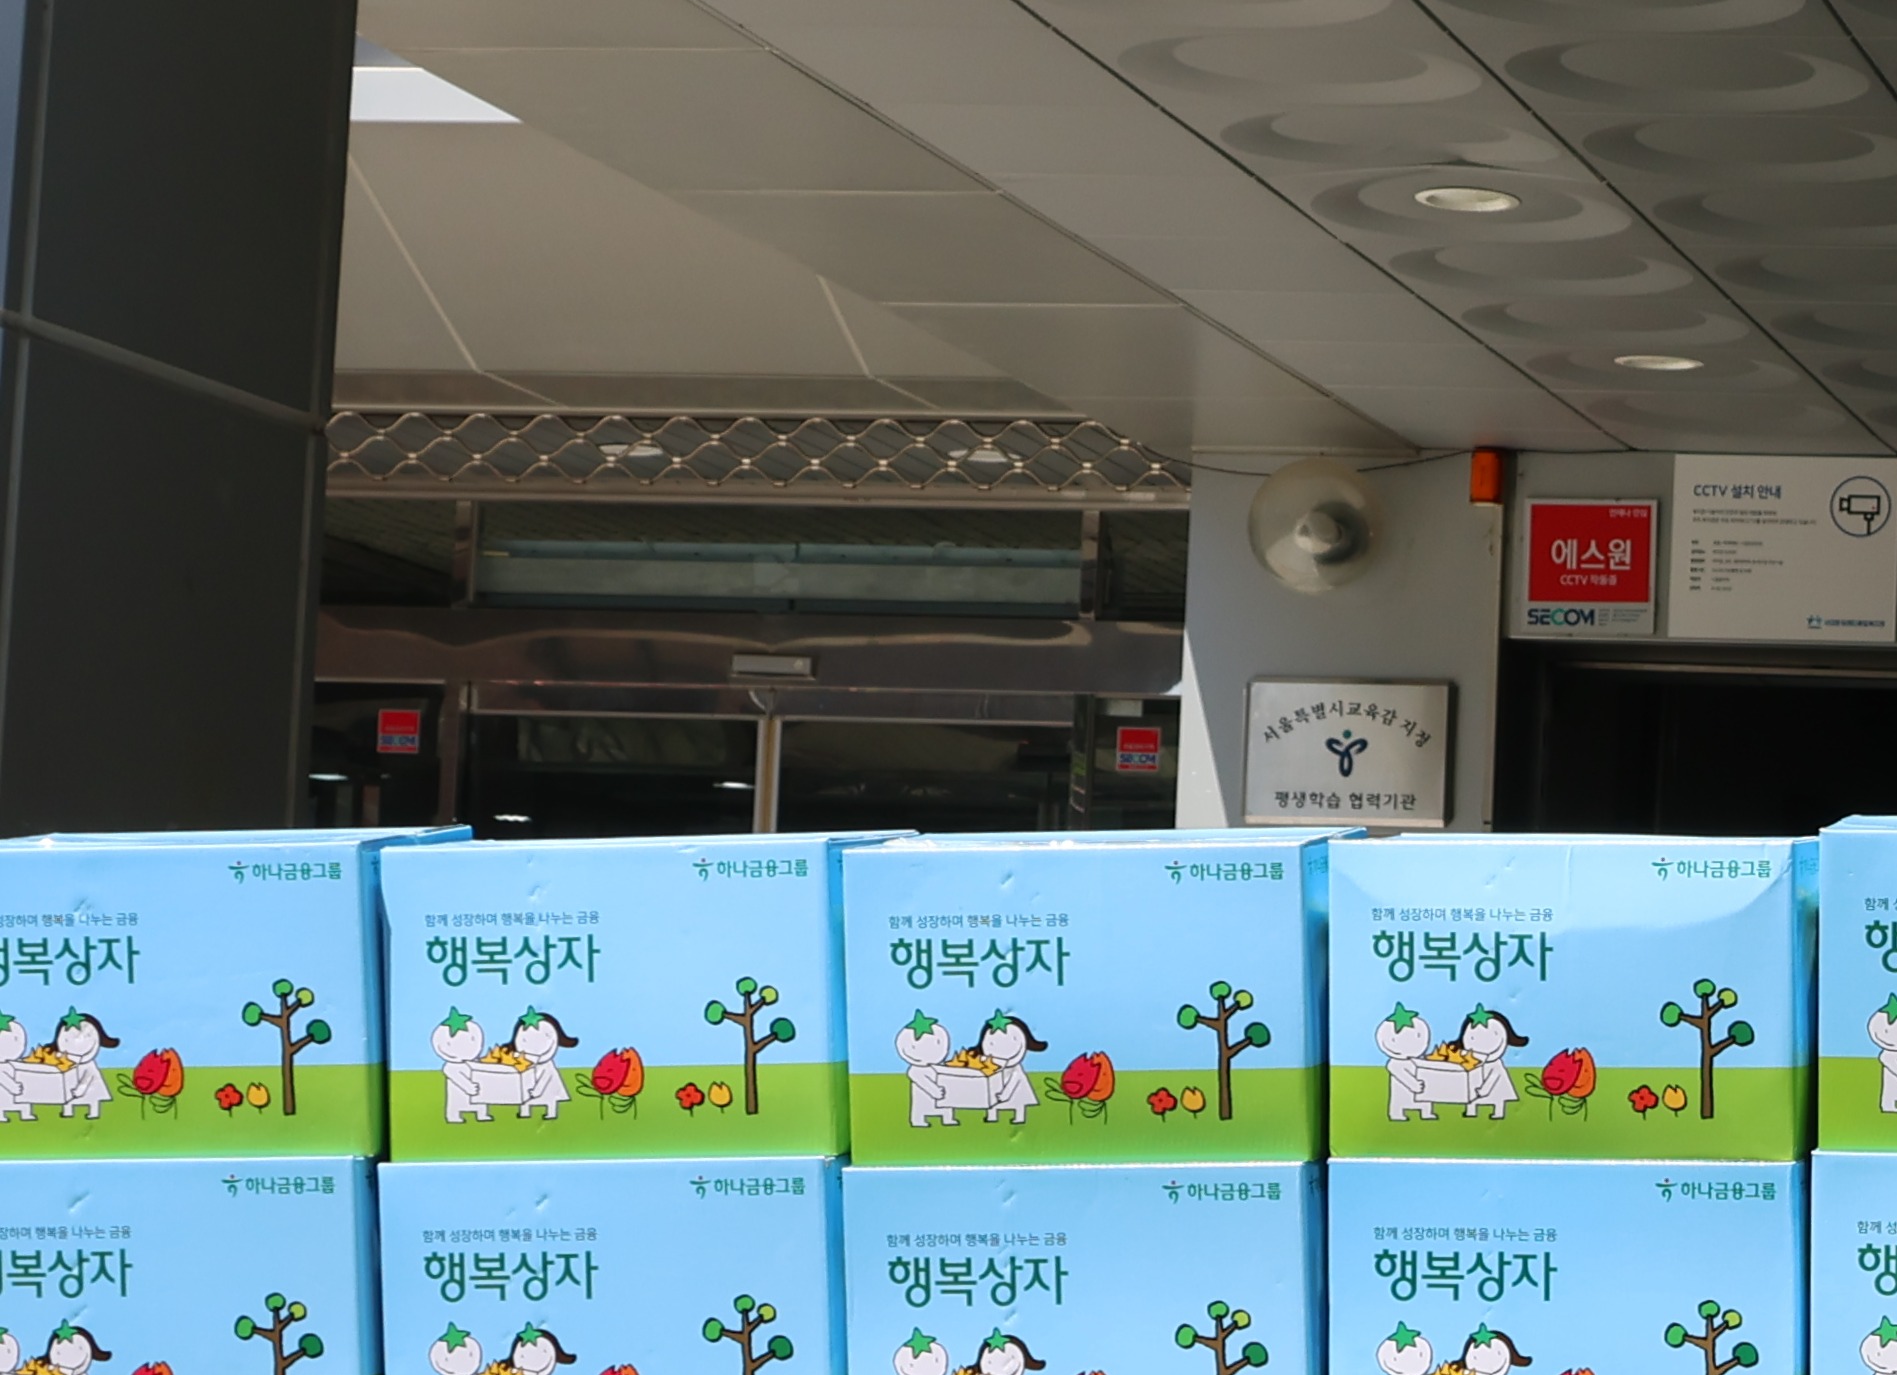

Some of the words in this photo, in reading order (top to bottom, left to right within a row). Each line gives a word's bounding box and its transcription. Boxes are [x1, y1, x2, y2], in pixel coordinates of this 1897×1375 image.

[1693, 485, 1728, 497] CCTV
[1731, 484, 1754, 499] 설치
[1757, 484, 1782, 500] 안내
[1551, 538, 1632, 570] 에스원
[1560, 574, 1588, 586] CCTV
[1527, 608, 1595, 625] SECOM
[1263, 700, 1398, 744] 서울특별시교육감
[1401, 720, 1431, 748] 지정
[1274, 791, 1341, 810] 평생학습
[1349, 792, 1416, 811] 협력기관
[251, 861, 342, 881] 하나금융그룹
[716, 858, 809, 879] 하나금융그룹
[1189, 861, 1285, 882] 하나금융그룹
[424, 913, 449, 928] 함께
[451, 912, 498, 928] 성장하며
[500, 911, 538, 927] 행복을
[537, 911, 574, 926] 나누는
[576, 910, 600, 925] 금융
[425, 933, 601, 987] 행복상자
[889, 936, 1071, 990] 행복상자
[1372, 929, 1554, 983] 행복상자
[244, 1175, 336, 1195] 하나금융그룹
[713, 1176, 806, 1197] 하나금융그룹
[1680, 1181, 1777, 1201] 하나금융그룹
[423, 1250, 599, 1303] 행복상자
[887, 1255, 1069, 1308] 행복상자
[1374, 1248, 1558, 1303] 행복상자
